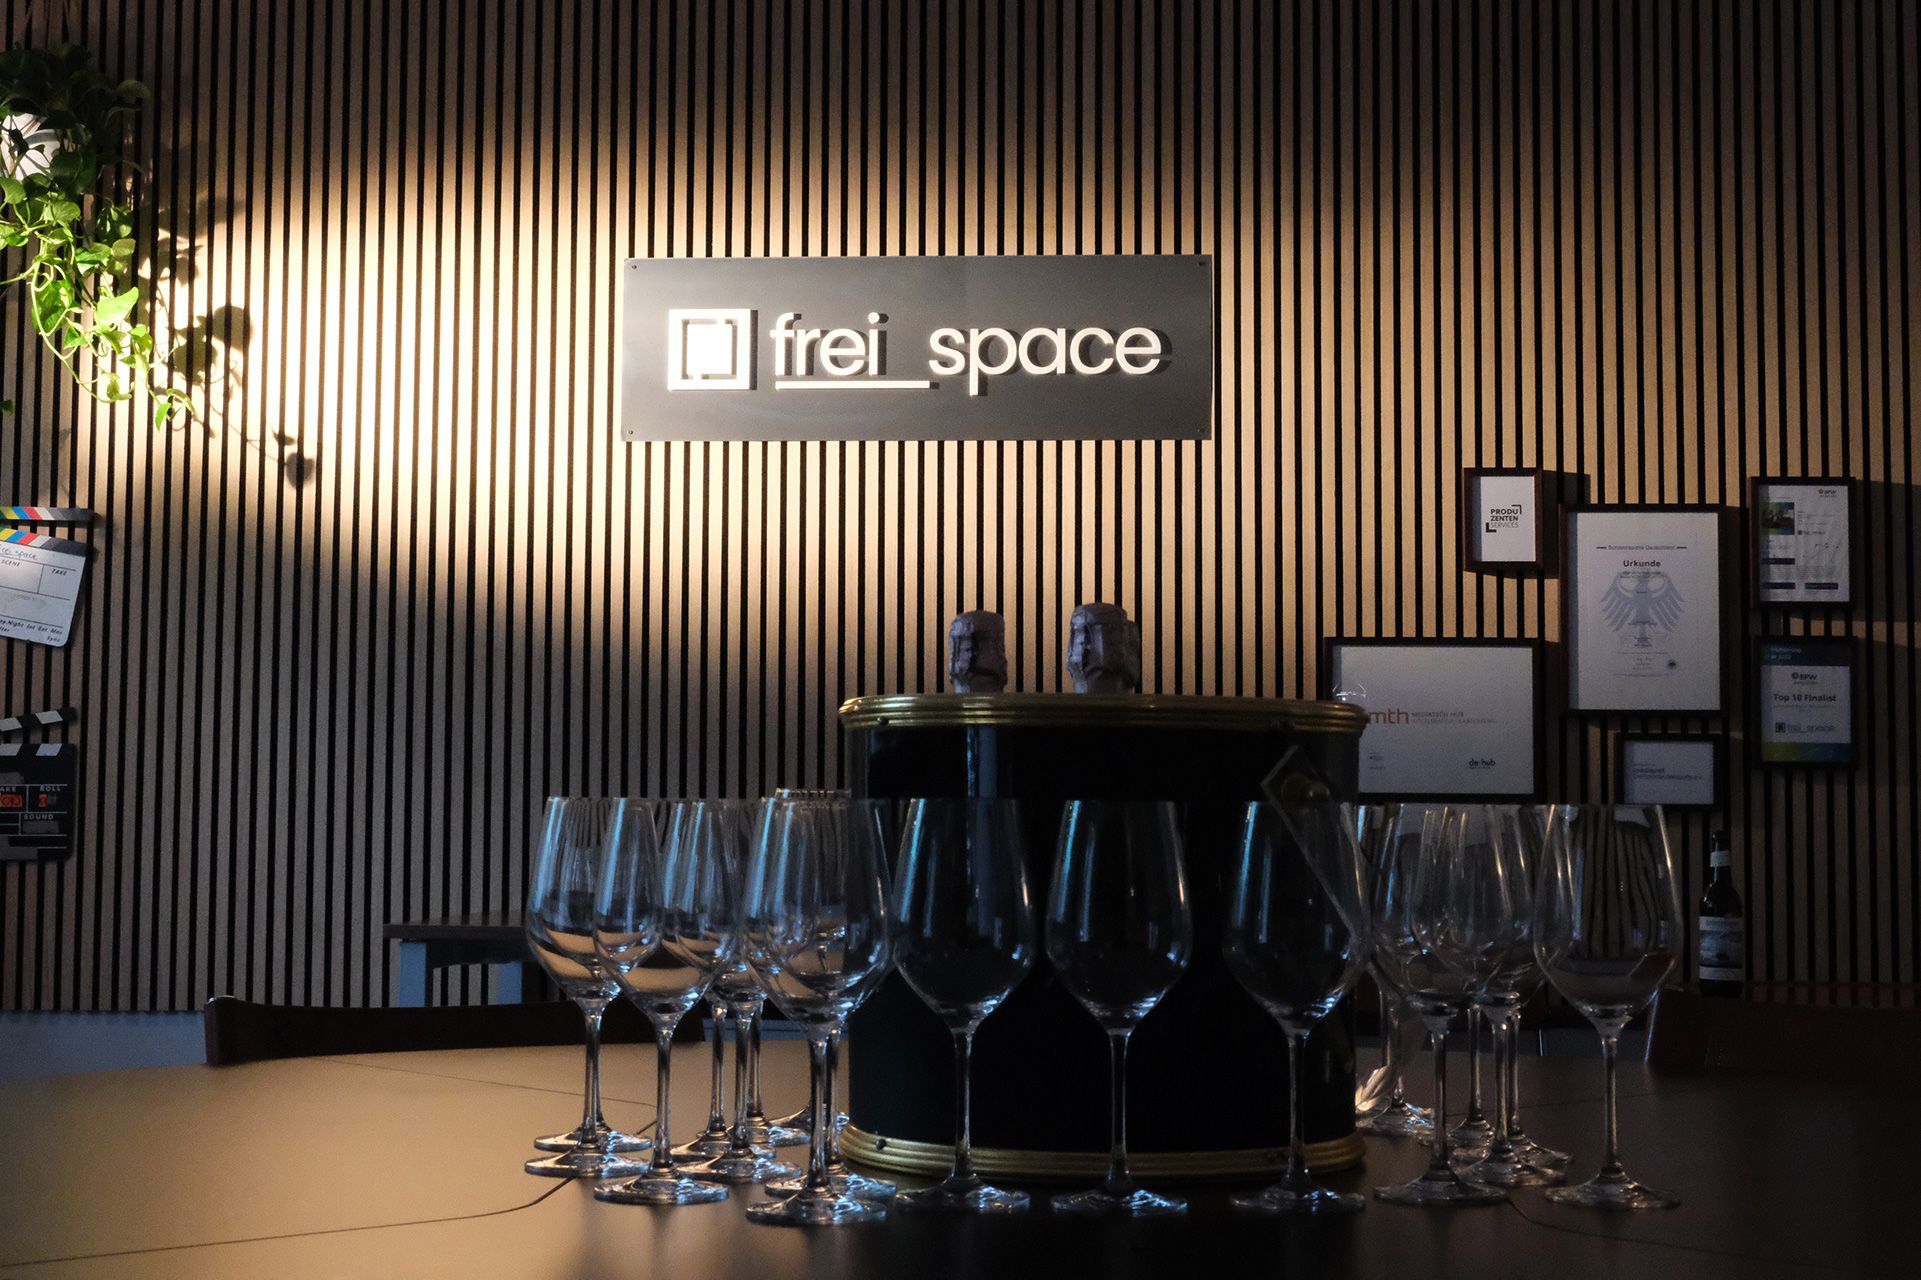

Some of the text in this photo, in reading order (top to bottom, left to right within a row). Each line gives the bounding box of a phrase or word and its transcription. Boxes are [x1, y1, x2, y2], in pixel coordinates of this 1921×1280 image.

[929, 326, 1162, 397] space
[1623, 560, 1661, 568] Urkunde
[51, 568, 68, 577] TAKE
[1773, 693, 1837, 703] Top 10 Finalist
[1368, 708, 1410, 725] mth
